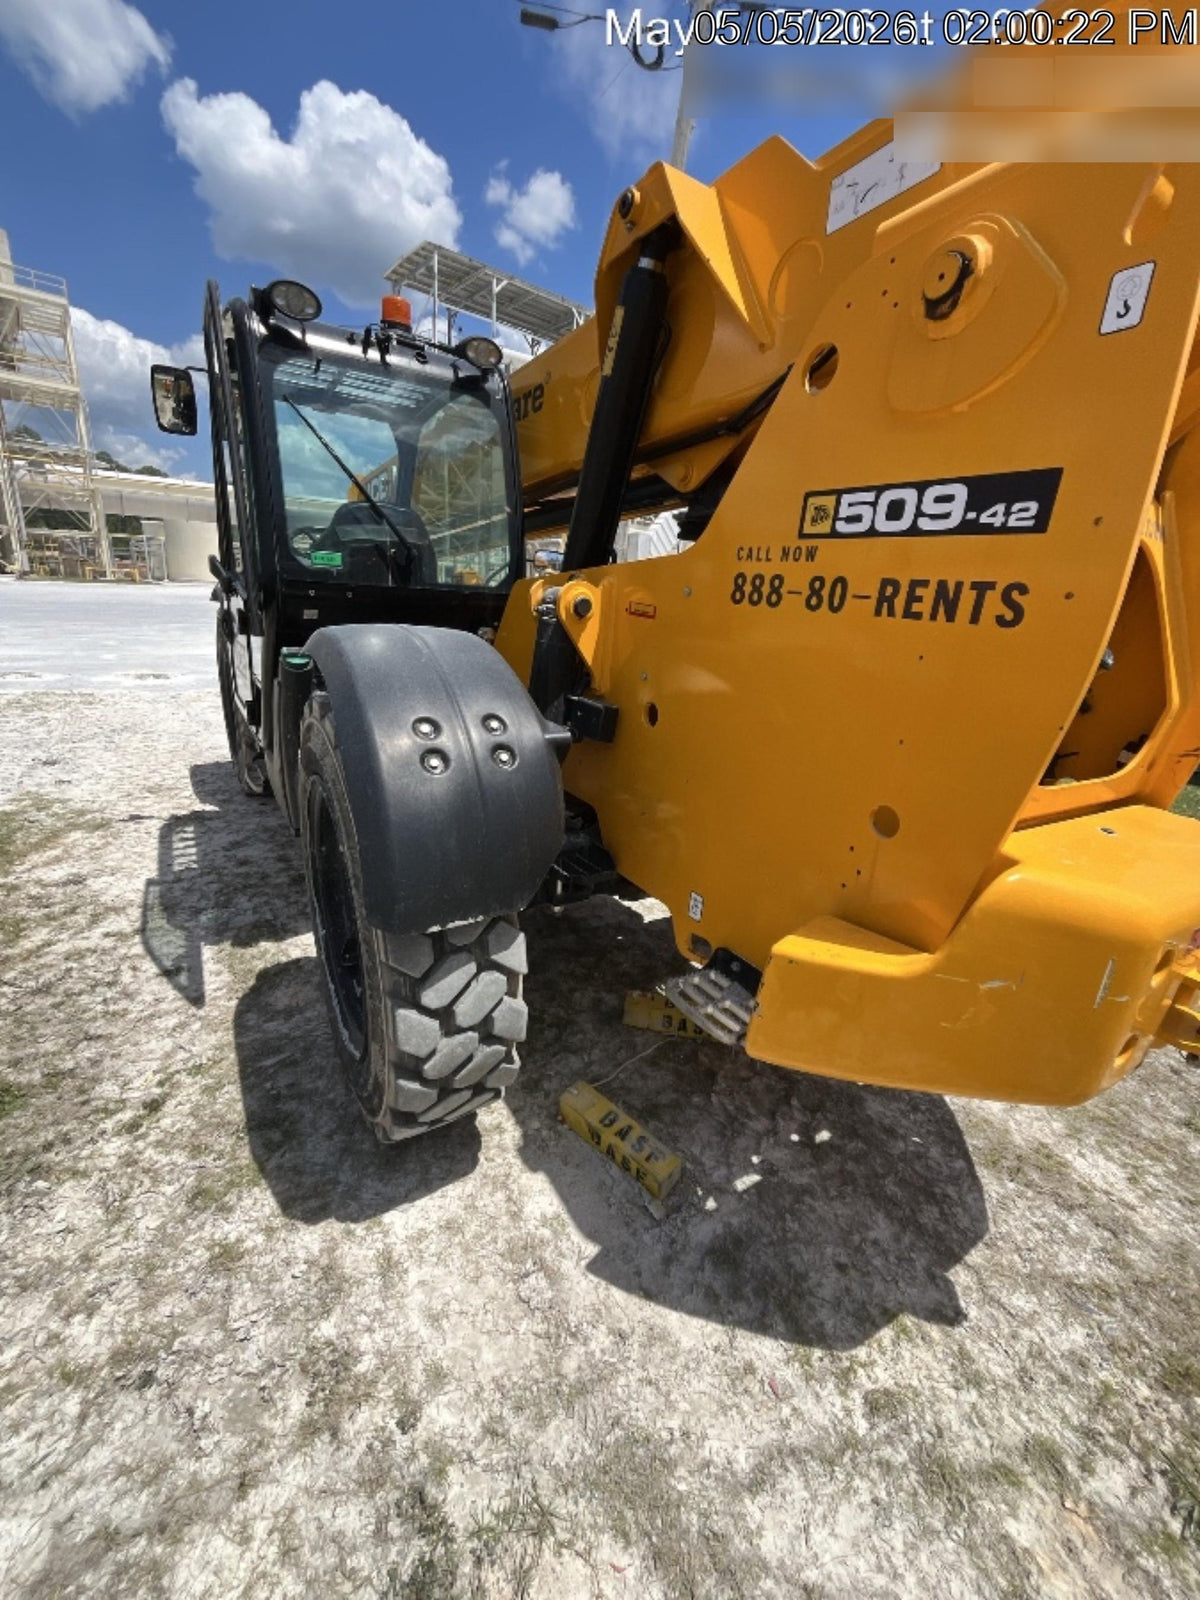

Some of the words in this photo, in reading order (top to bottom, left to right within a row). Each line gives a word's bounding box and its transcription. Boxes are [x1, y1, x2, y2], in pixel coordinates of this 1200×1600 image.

[835, 483, 1039, 533] 509-42
[737, 546, 773, 562] CALL
[780, 546, 819, 563] NOW
[731, 572, 1030, 628] 888-80-RENTS
